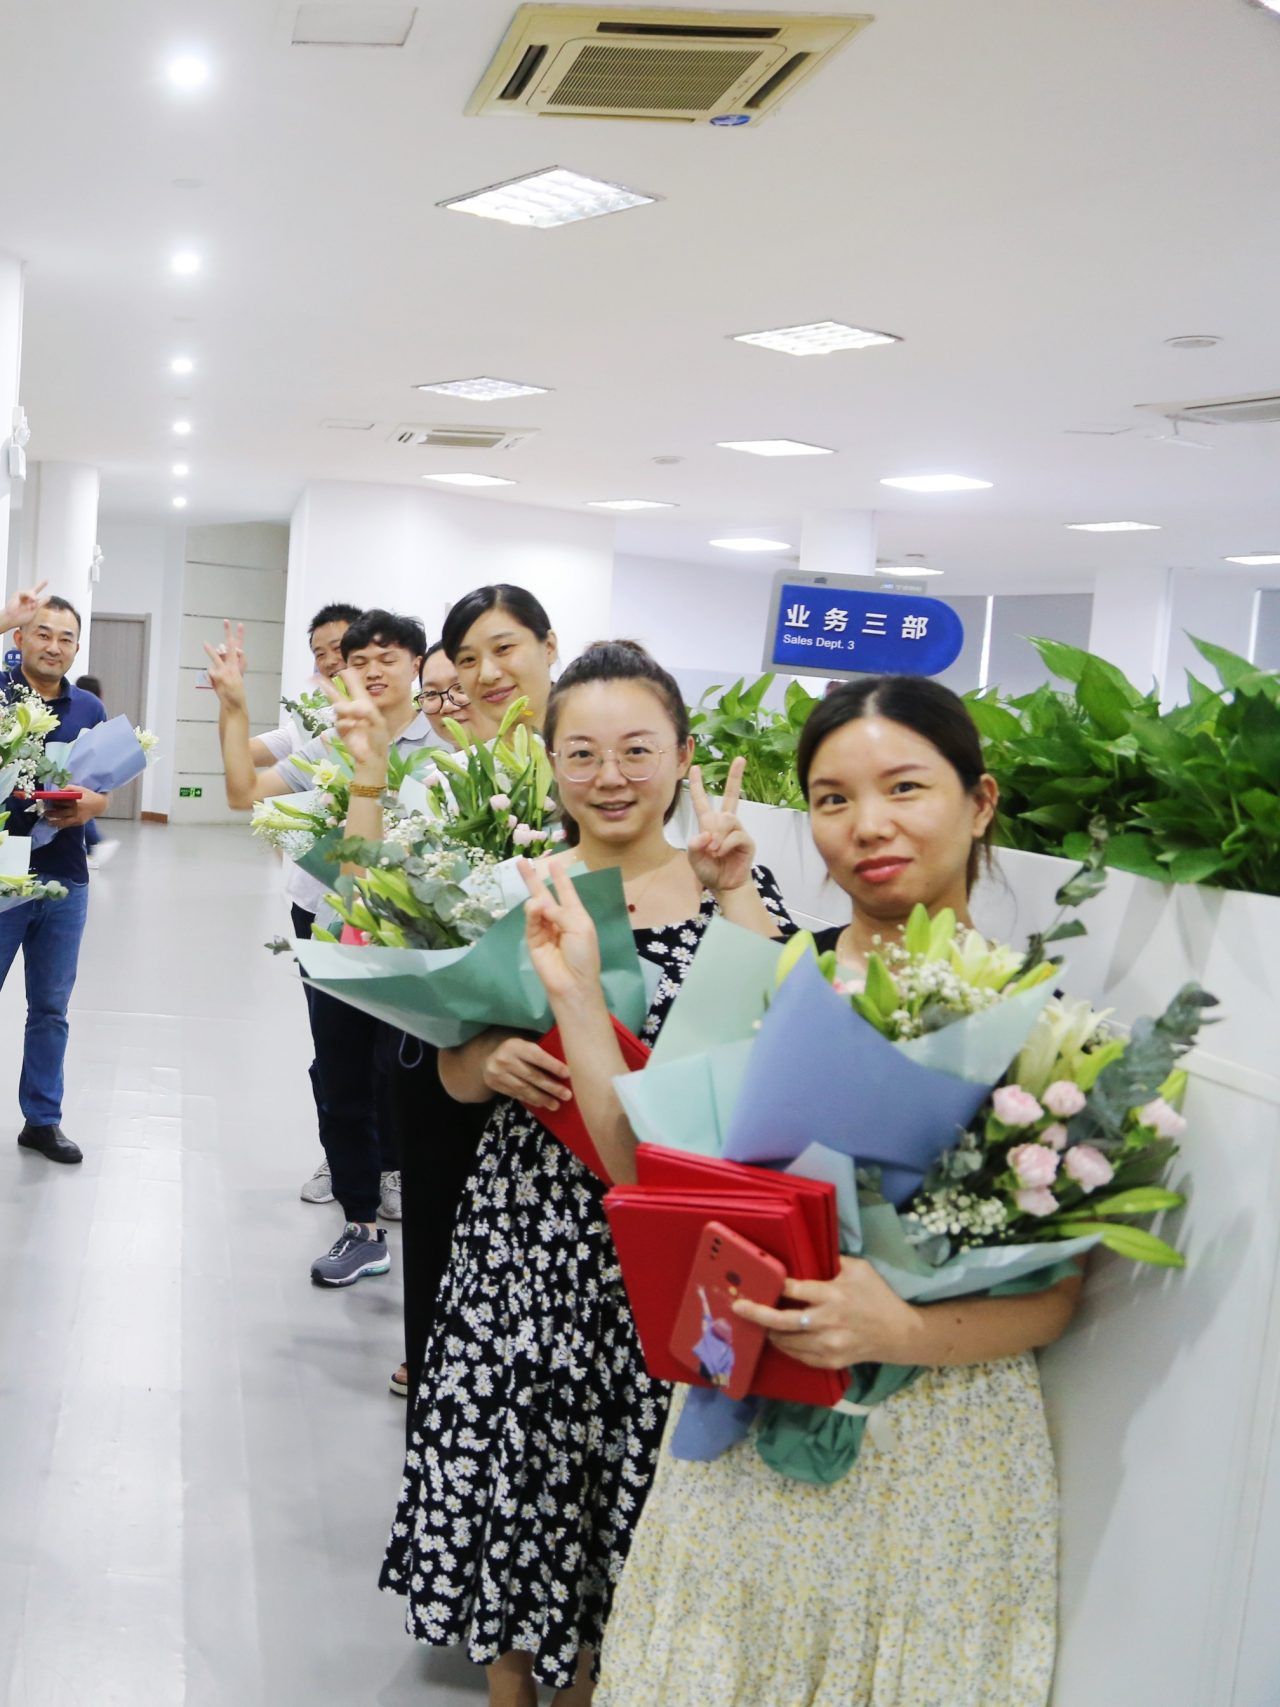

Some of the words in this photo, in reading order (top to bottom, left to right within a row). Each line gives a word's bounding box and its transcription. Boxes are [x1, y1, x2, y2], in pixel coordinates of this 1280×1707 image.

[785, 604, 928, 639] 业务三部
[783, 634, 813, 646] Sales
[816, 637, 844, 650] Dept.
[847, 640, 855, 650] 3
